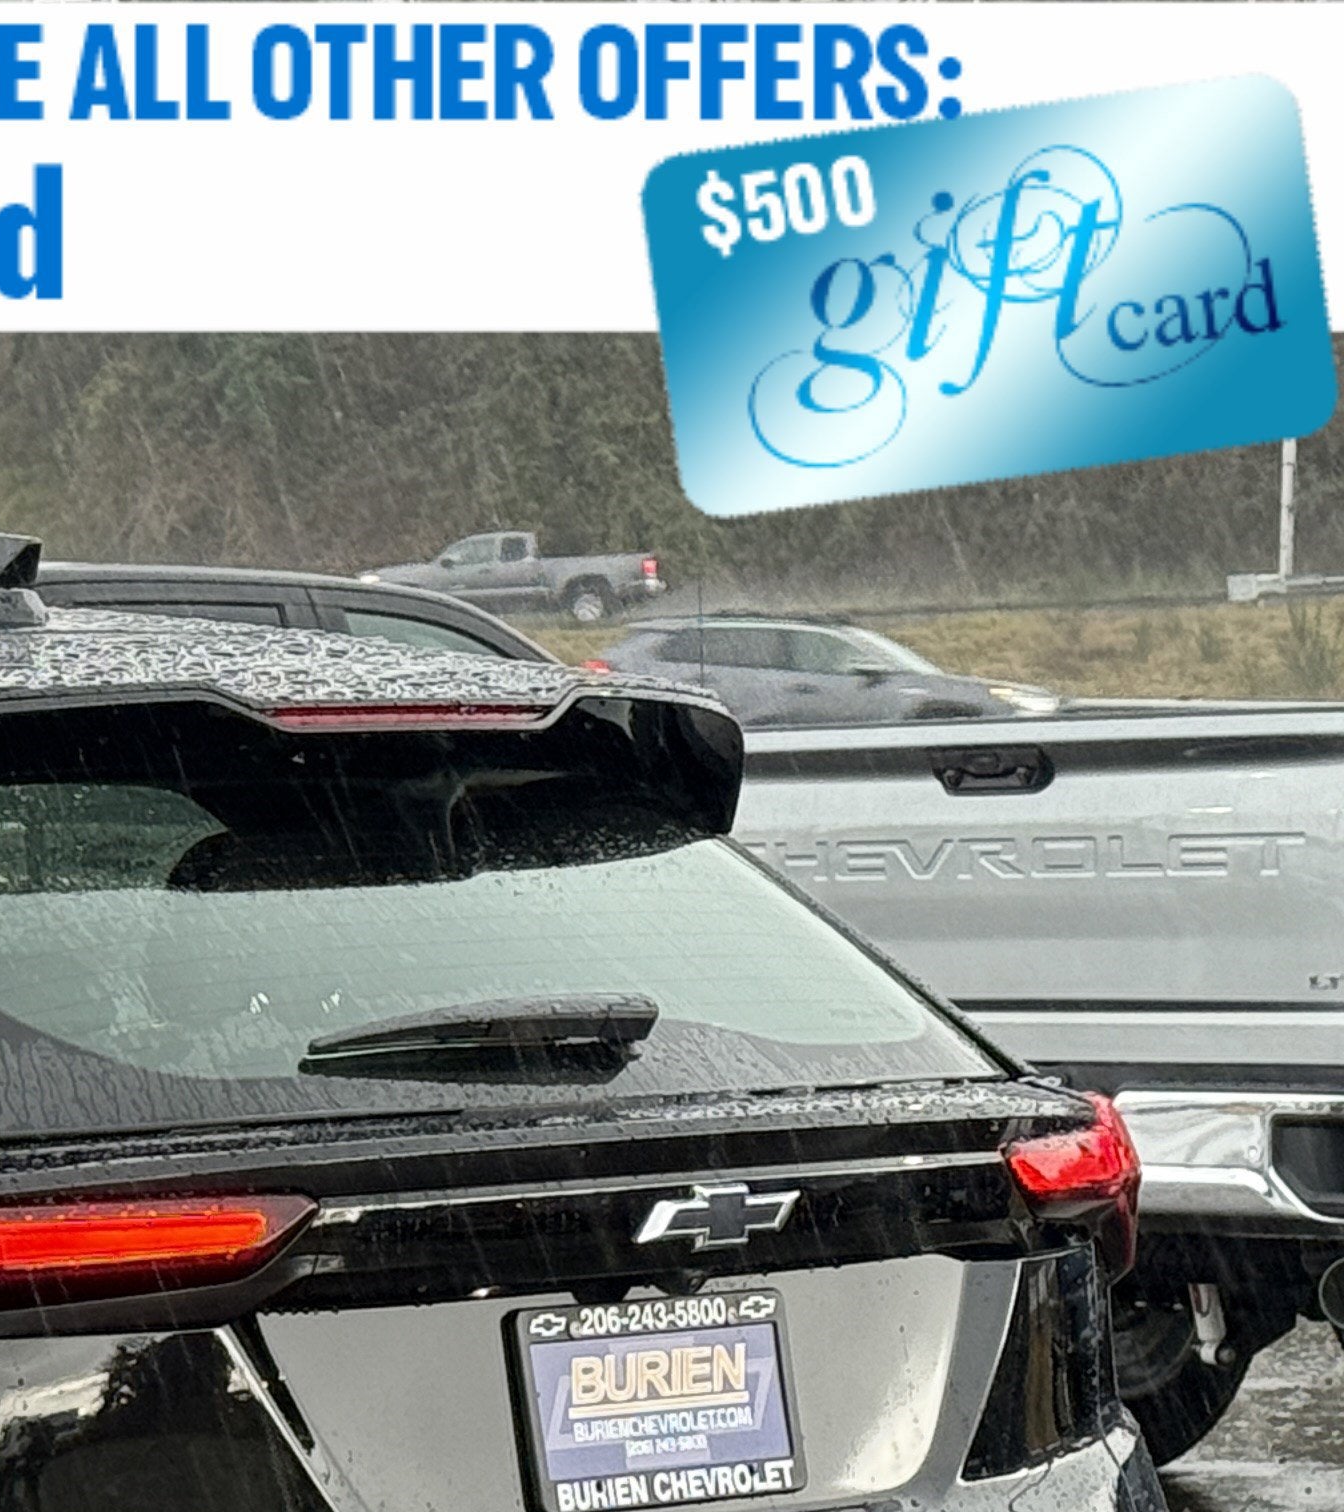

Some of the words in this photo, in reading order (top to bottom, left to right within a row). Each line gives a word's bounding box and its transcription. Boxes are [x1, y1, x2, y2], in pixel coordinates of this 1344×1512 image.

[742, 832, 1306, 882] HEVROLET
[578, 1296, 727, 1337] 206-243-5800
[571, 1342, 747, 1404] BURIEN
